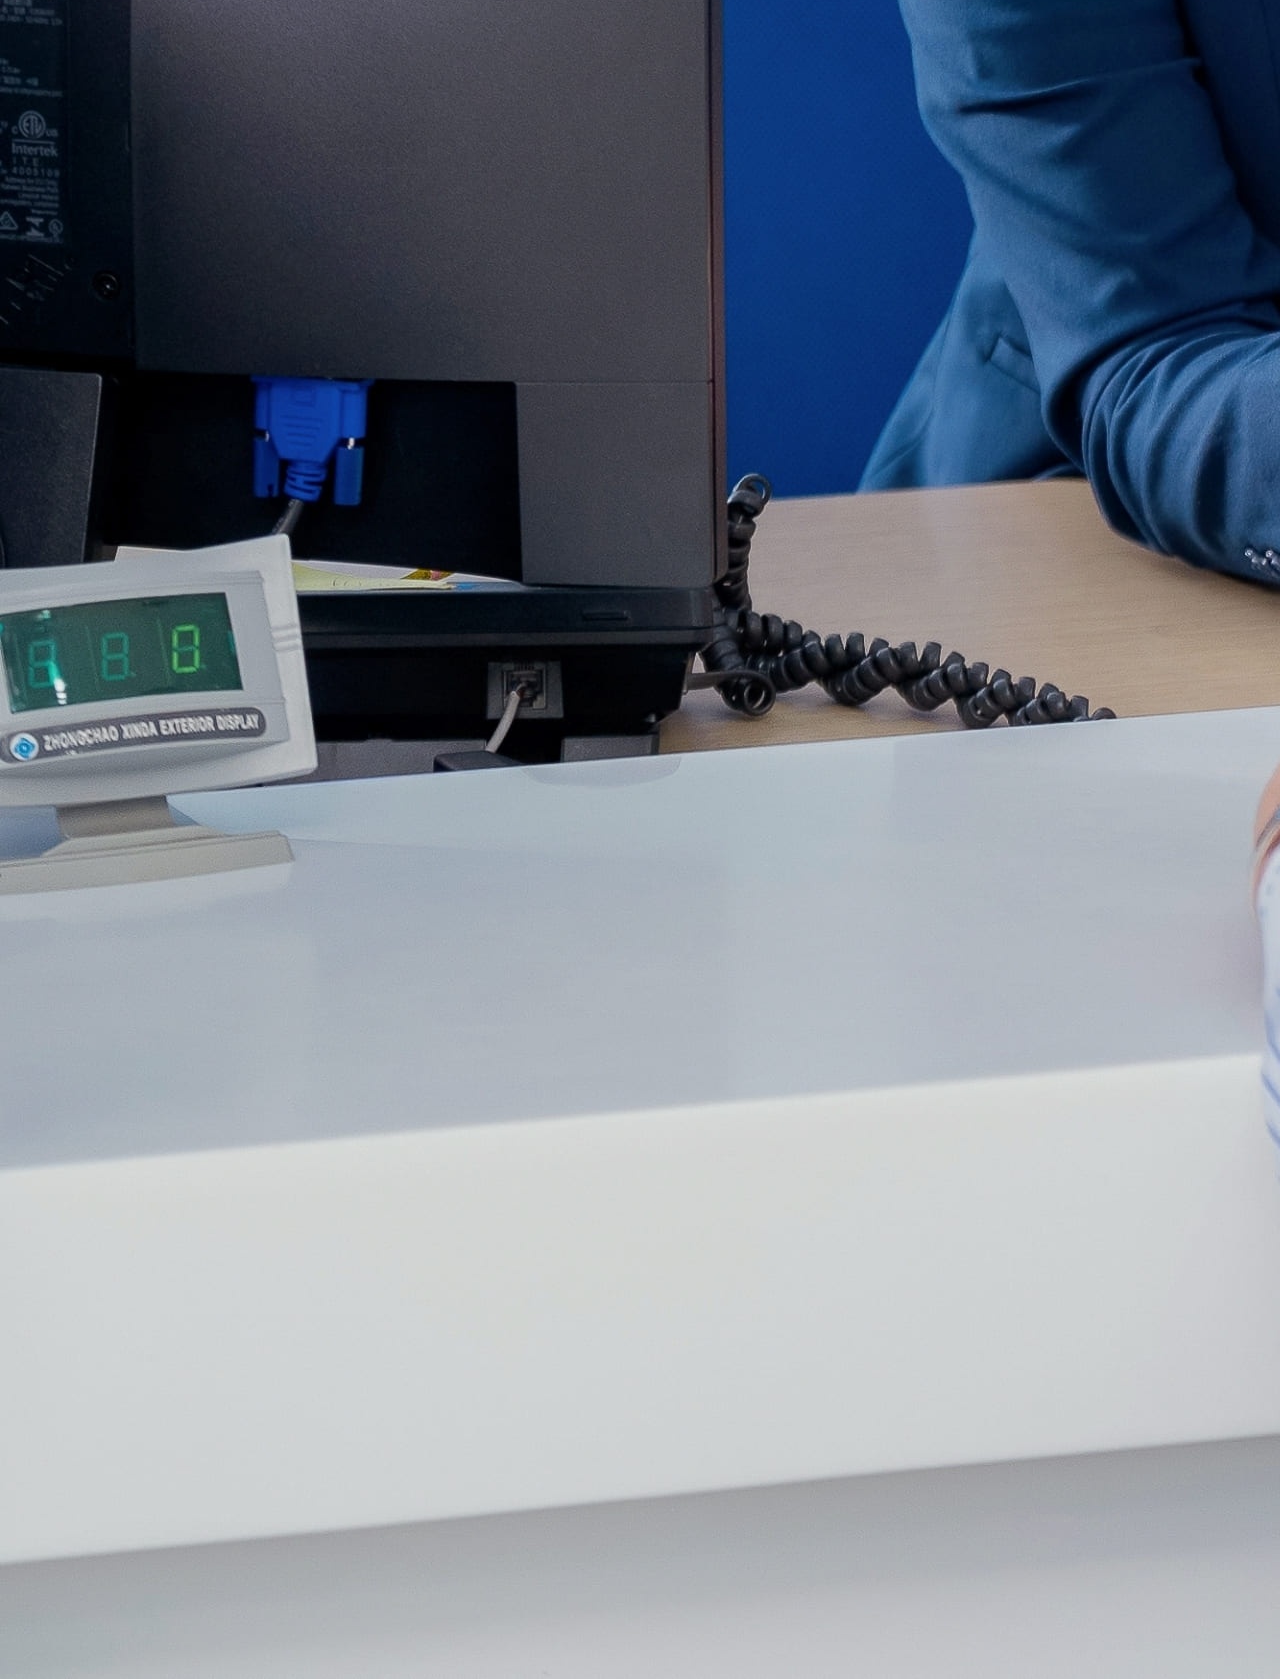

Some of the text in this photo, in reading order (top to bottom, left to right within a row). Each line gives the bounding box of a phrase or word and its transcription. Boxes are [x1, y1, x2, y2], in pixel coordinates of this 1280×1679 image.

[11, 142, 59, 157] Intertek
[43, 713, 260, 752] ZHONGCHAO XINDA EXTERIOR DISPLAY
